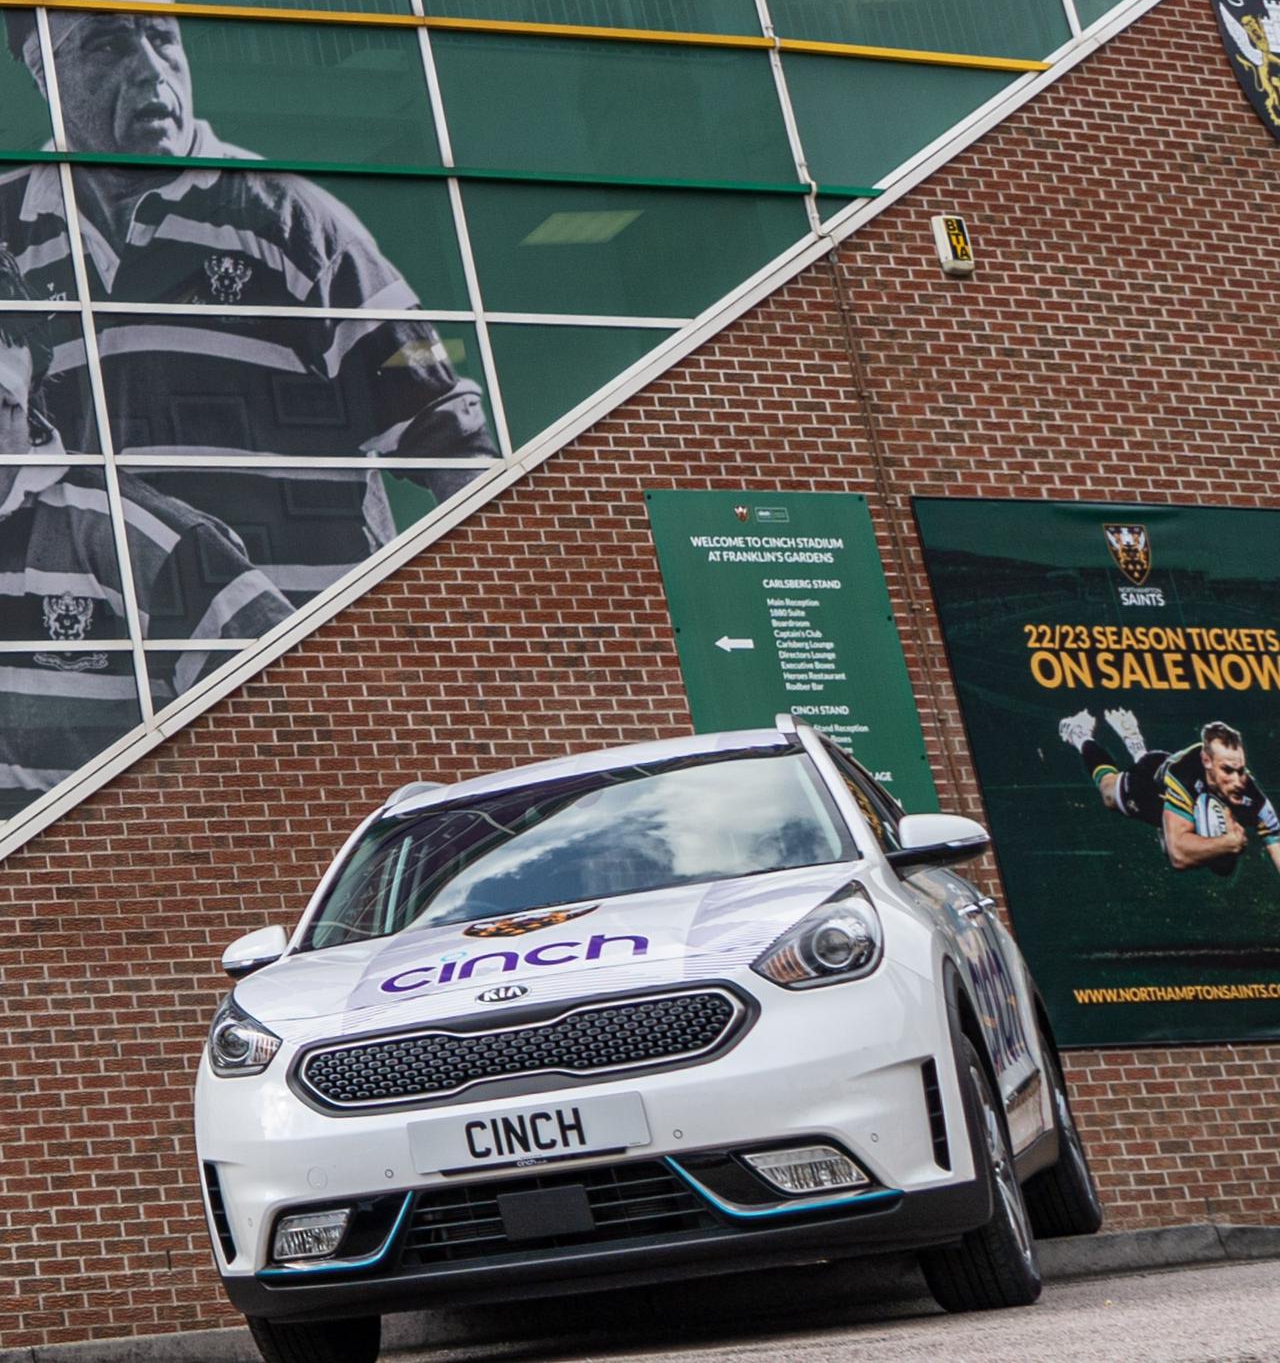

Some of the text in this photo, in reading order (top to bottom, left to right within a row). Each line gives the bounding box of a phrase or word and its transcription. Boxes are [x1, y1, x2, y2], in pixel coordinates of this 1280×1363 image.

[690, 536, 844, 549] WELCOME TO CINCH STADIUM
[708, 551, 834, 563] AT FRANKLIN'S GARDENS
[762, 579, 841, 589] CARLSBERG STAND
[1120, 593, 1166, 607] SAINTS
[1024, 624, 1280, 652] 22/23 SEASON TICKETS
[1030, 650, 1280, 691] ON SALE NOW
[791, 706, 849, 715] CINCH STAND
[380, 934, 649, 993] cinch
[483, 985, 526, 1003] KIA
[1073, 983, 1280, 1004] WWW.NORTHAMPTONSAINTS.C
[464, 1107, 587, 1159] CINCH
